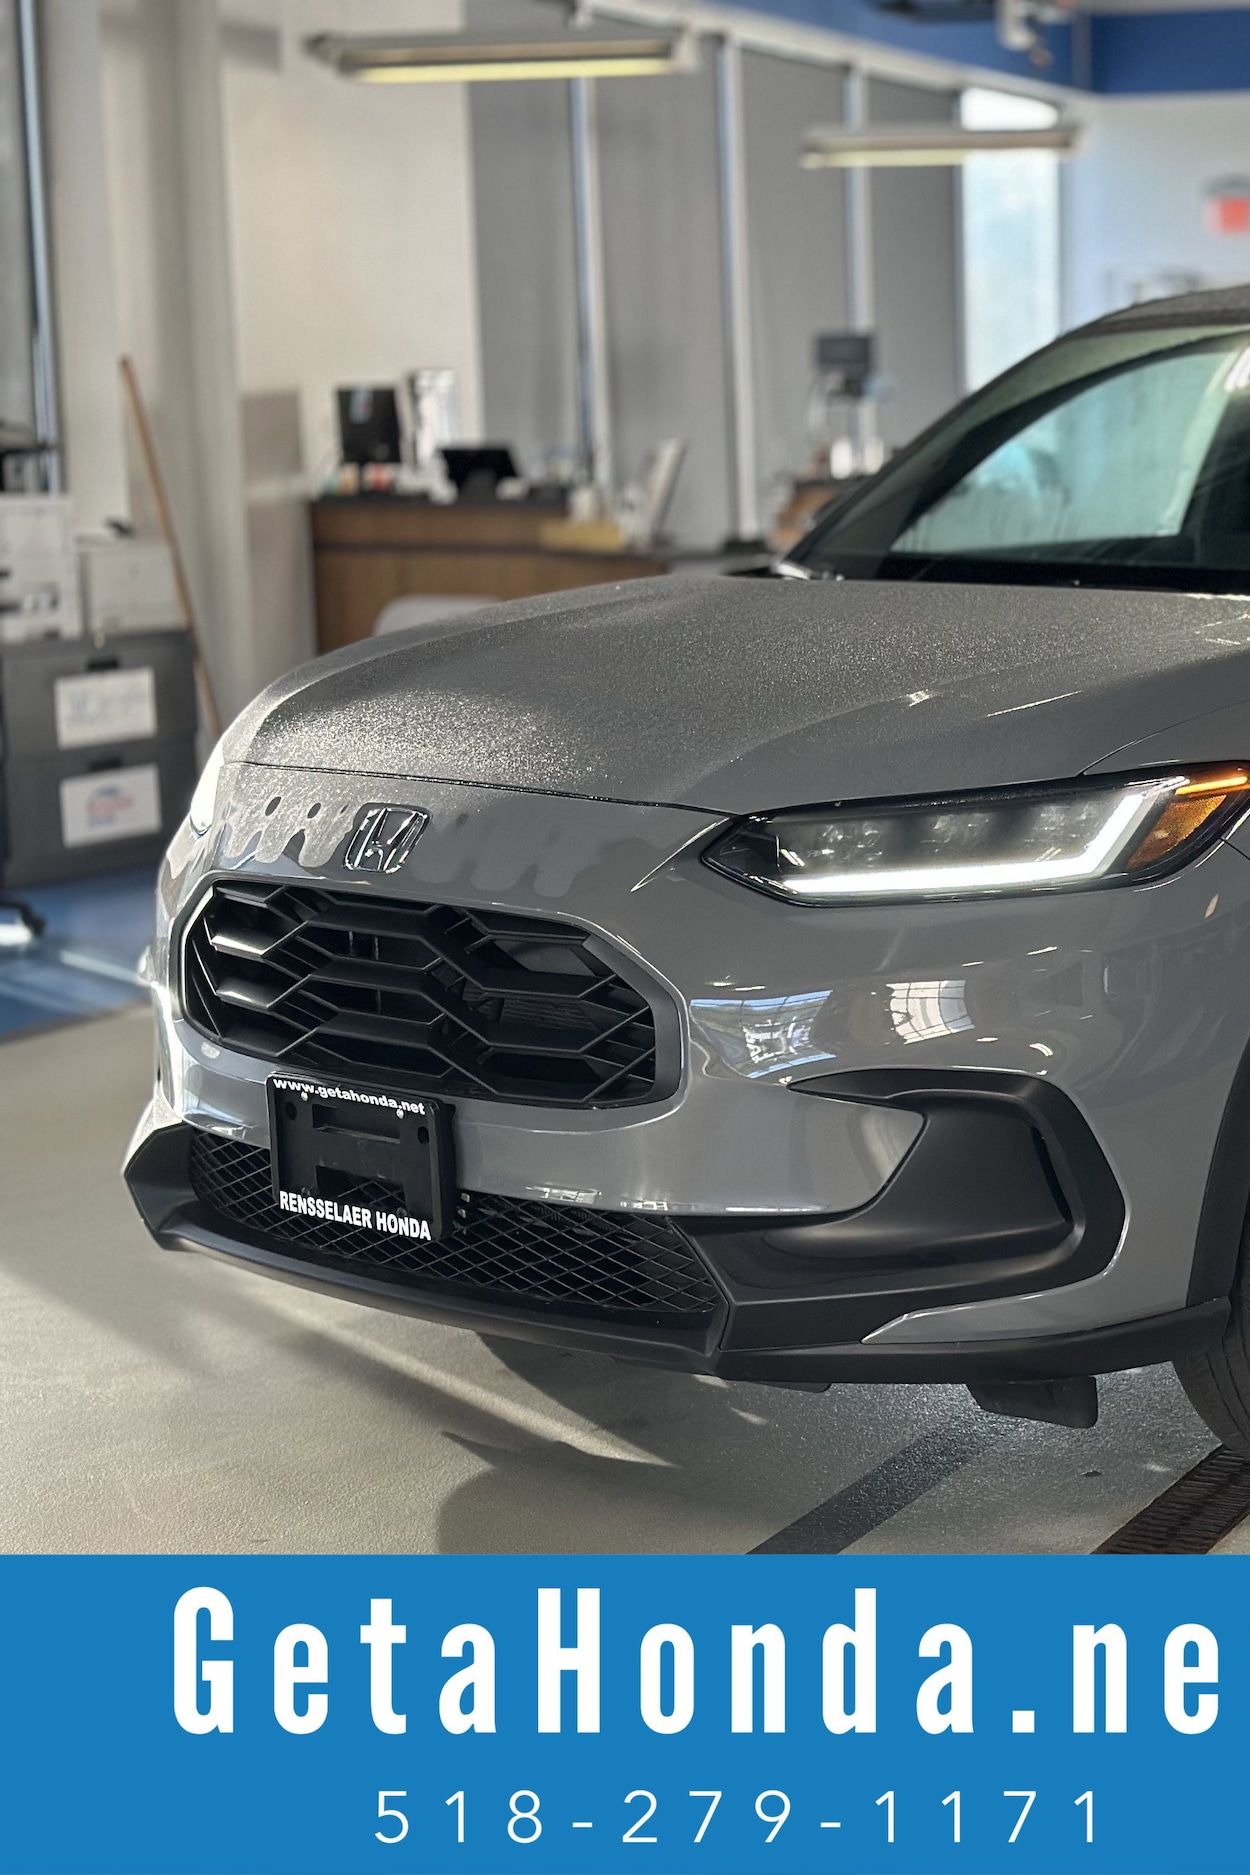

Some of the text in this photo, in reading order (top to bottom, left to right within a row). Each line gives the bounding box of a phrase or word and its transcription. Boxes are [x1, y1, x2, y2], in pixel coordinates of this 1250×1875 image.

[273, 1078, 425, 1115] www.getahonda.net
[279, 1190, 432, 1241] RENSSELAER HONDA
